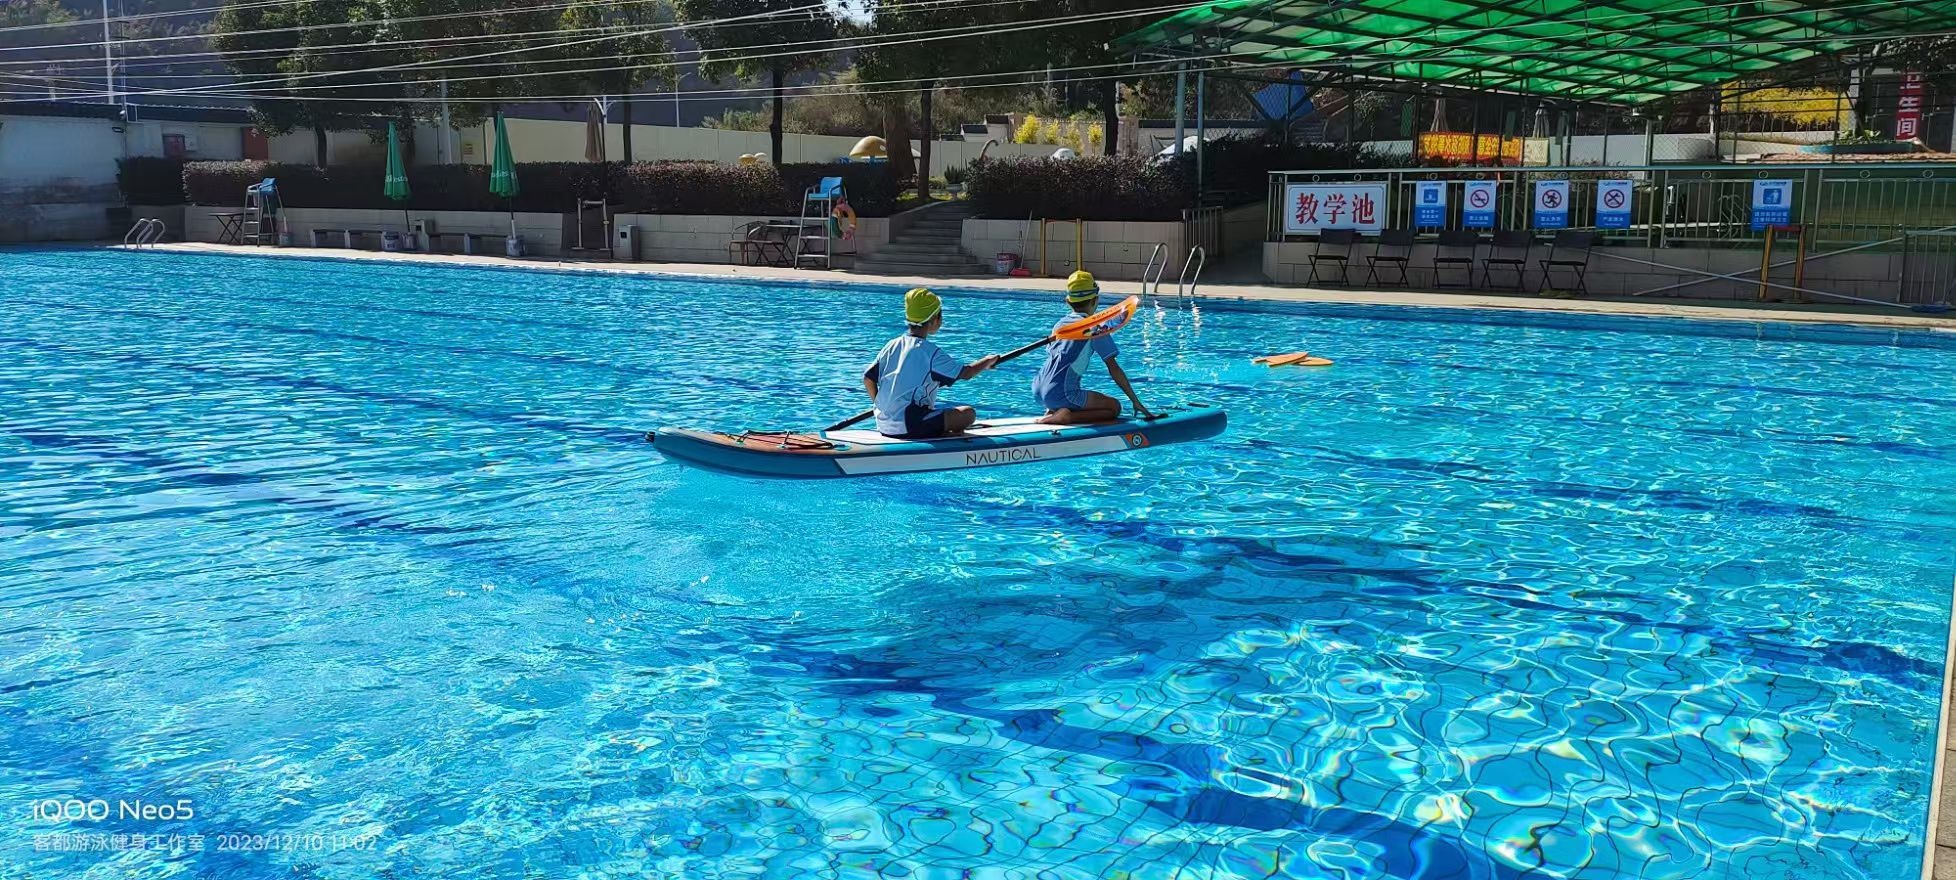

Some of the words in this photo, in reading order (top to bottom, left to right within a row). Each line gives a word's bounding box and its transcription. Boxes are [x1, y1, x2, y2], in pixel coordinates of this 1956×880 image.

[1296, 192, 1375, 224] 教学池
[966, 447, 1042, 466] NAUTICAL
